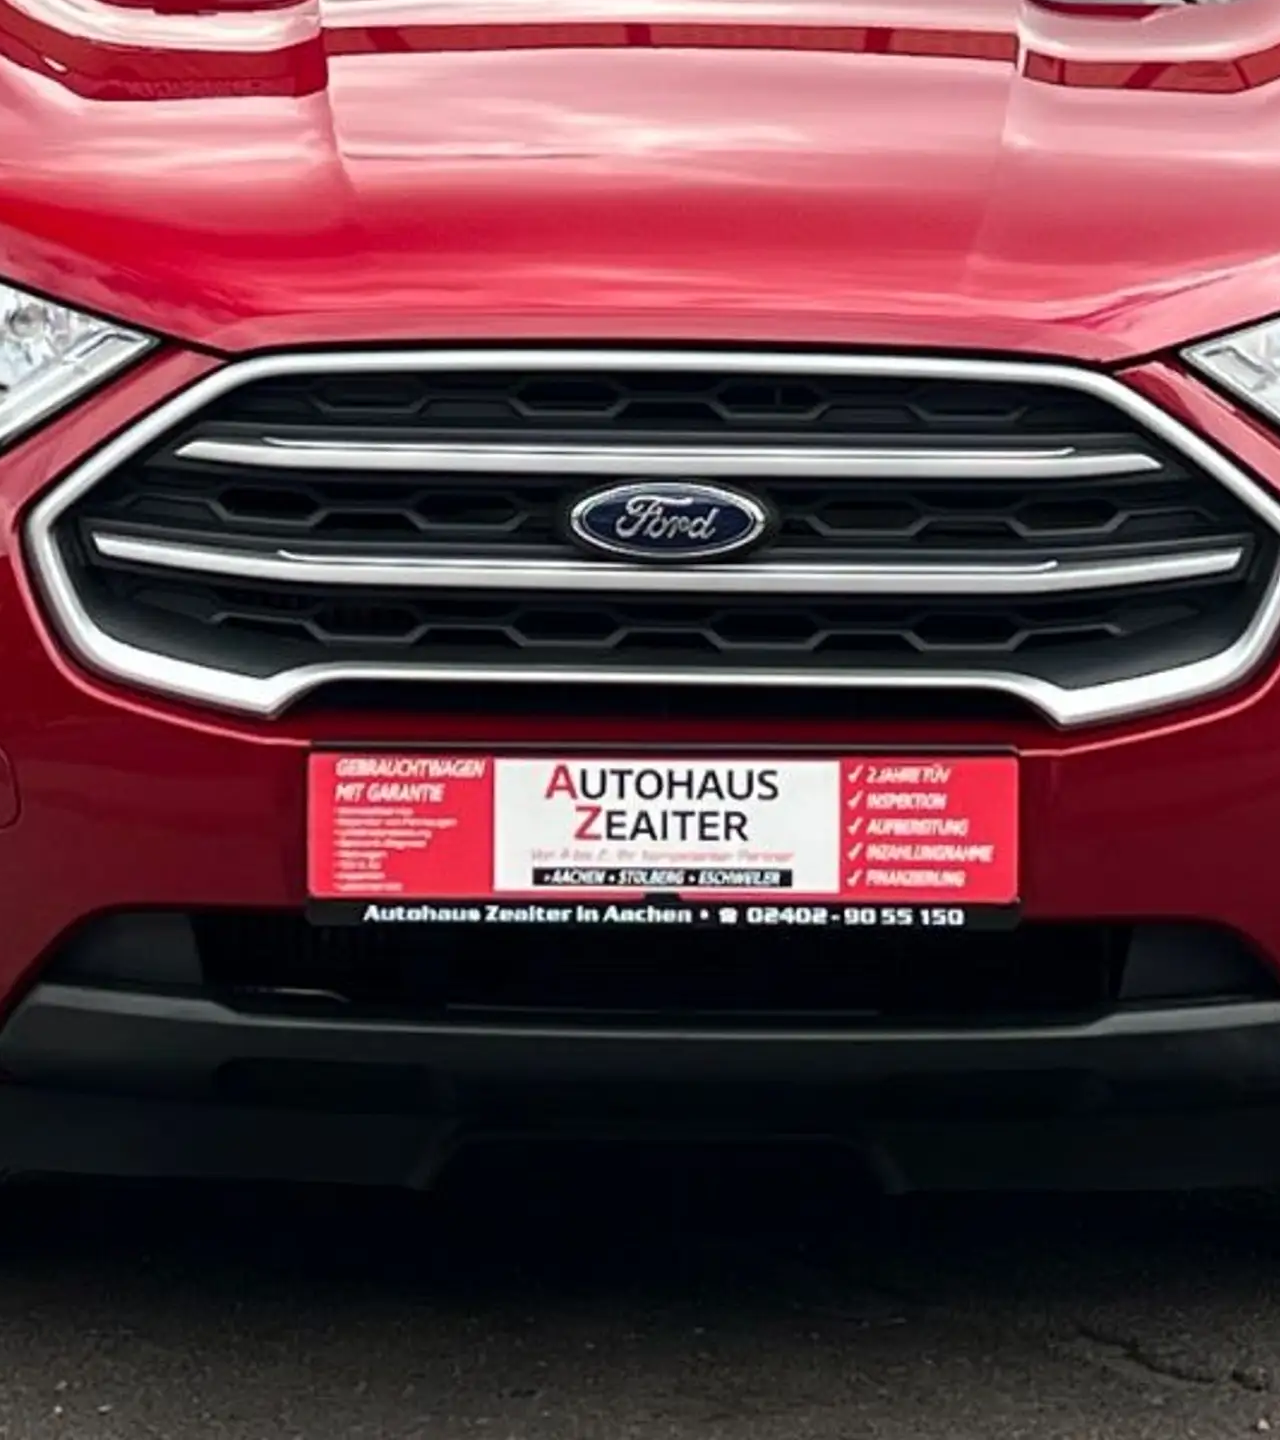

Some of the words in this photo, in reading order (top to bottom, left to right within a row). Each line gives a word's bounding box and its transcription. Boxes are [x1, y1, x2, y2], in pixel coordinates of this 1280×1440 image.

[615, 495, 720, 539] Ford
[335, 782, 365, 802] MIT
[367, 782, 445, 802] GARANTIE
[544, 763, 779, 801] AUTOHAUS
[574, 805, 749, 841] ZEAITER
[552, 869, 606, 884] AACHEN
[364, 904, 481, 922] Autohaus
[484, 904, 573, 922] Zeaiter
[602, 905, 692, 923] Aachen
[881, 908, 913, 925] 55
[920, 908, 965, 925] 150
